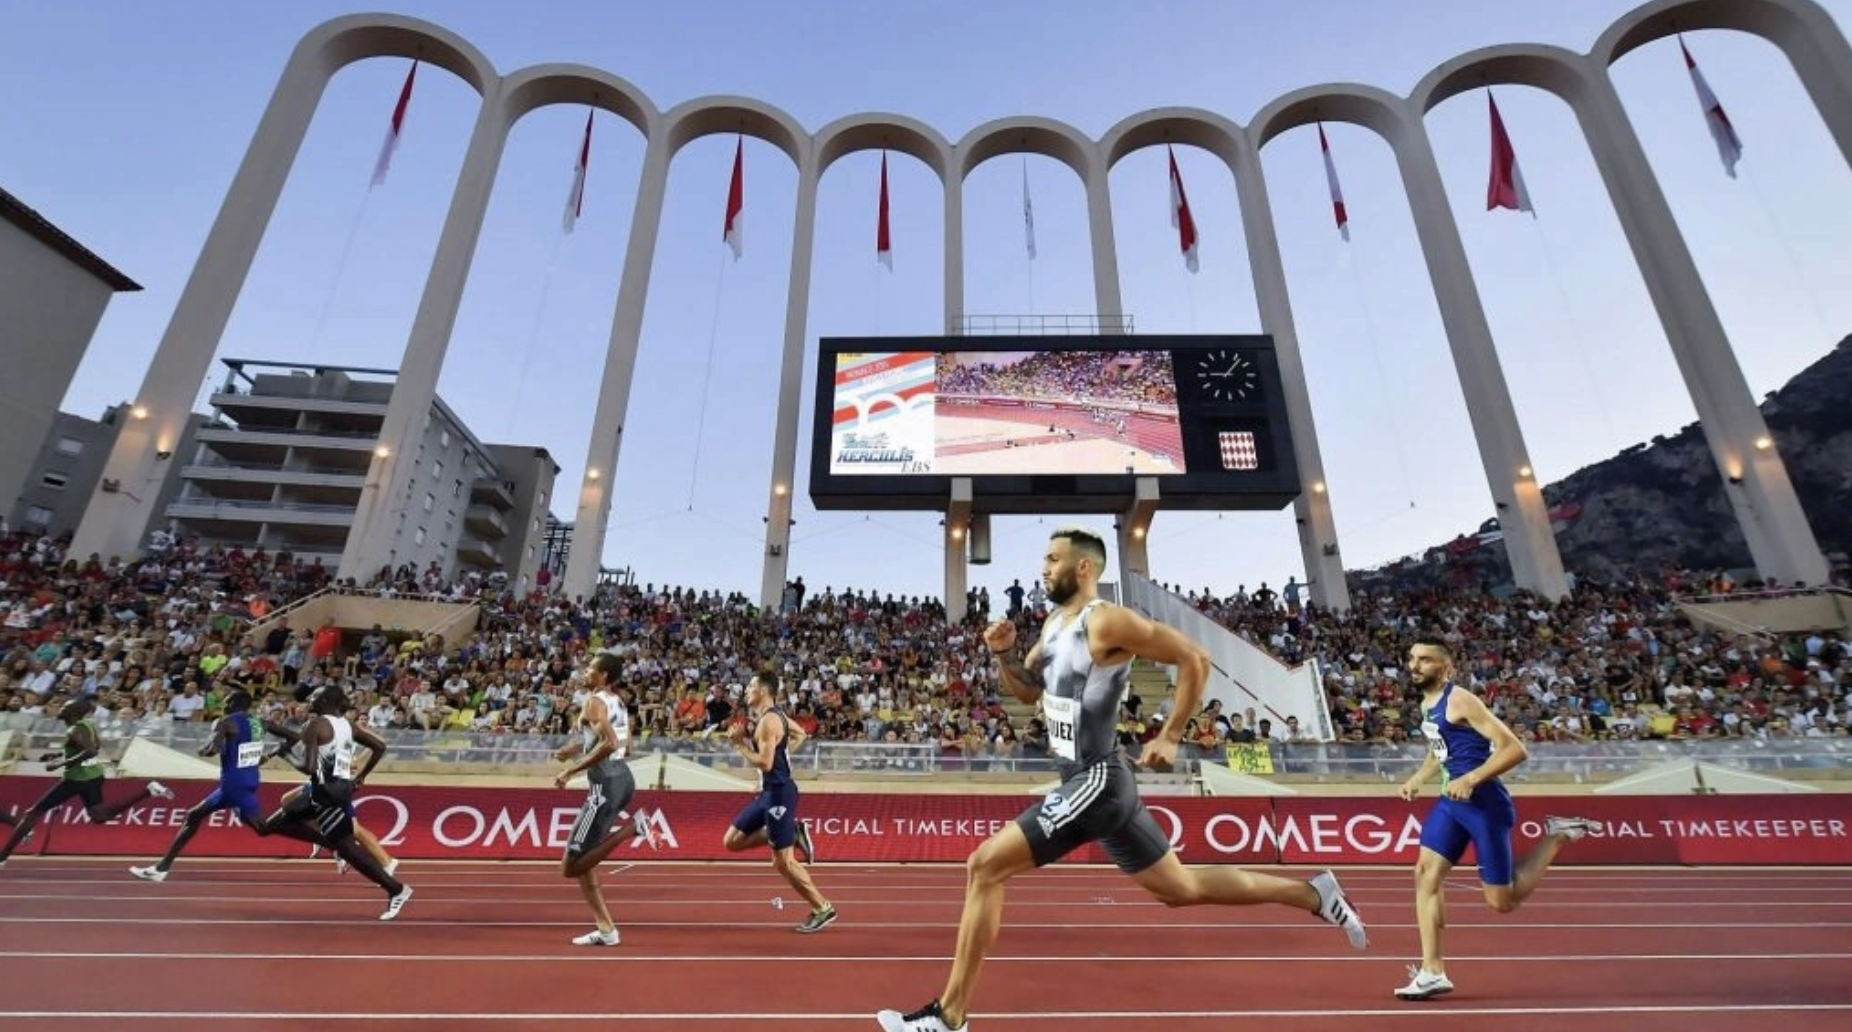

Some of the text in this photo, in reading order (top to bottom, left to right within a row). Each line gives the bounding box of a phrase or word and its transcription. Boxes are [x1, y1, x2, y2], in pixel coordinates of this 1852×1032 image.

[1045, 796, 1063, 813] 2
[1204, 813, 1423, 854] OMEGA
[1659, 819, 1847, 837] TIMEKEEPER
